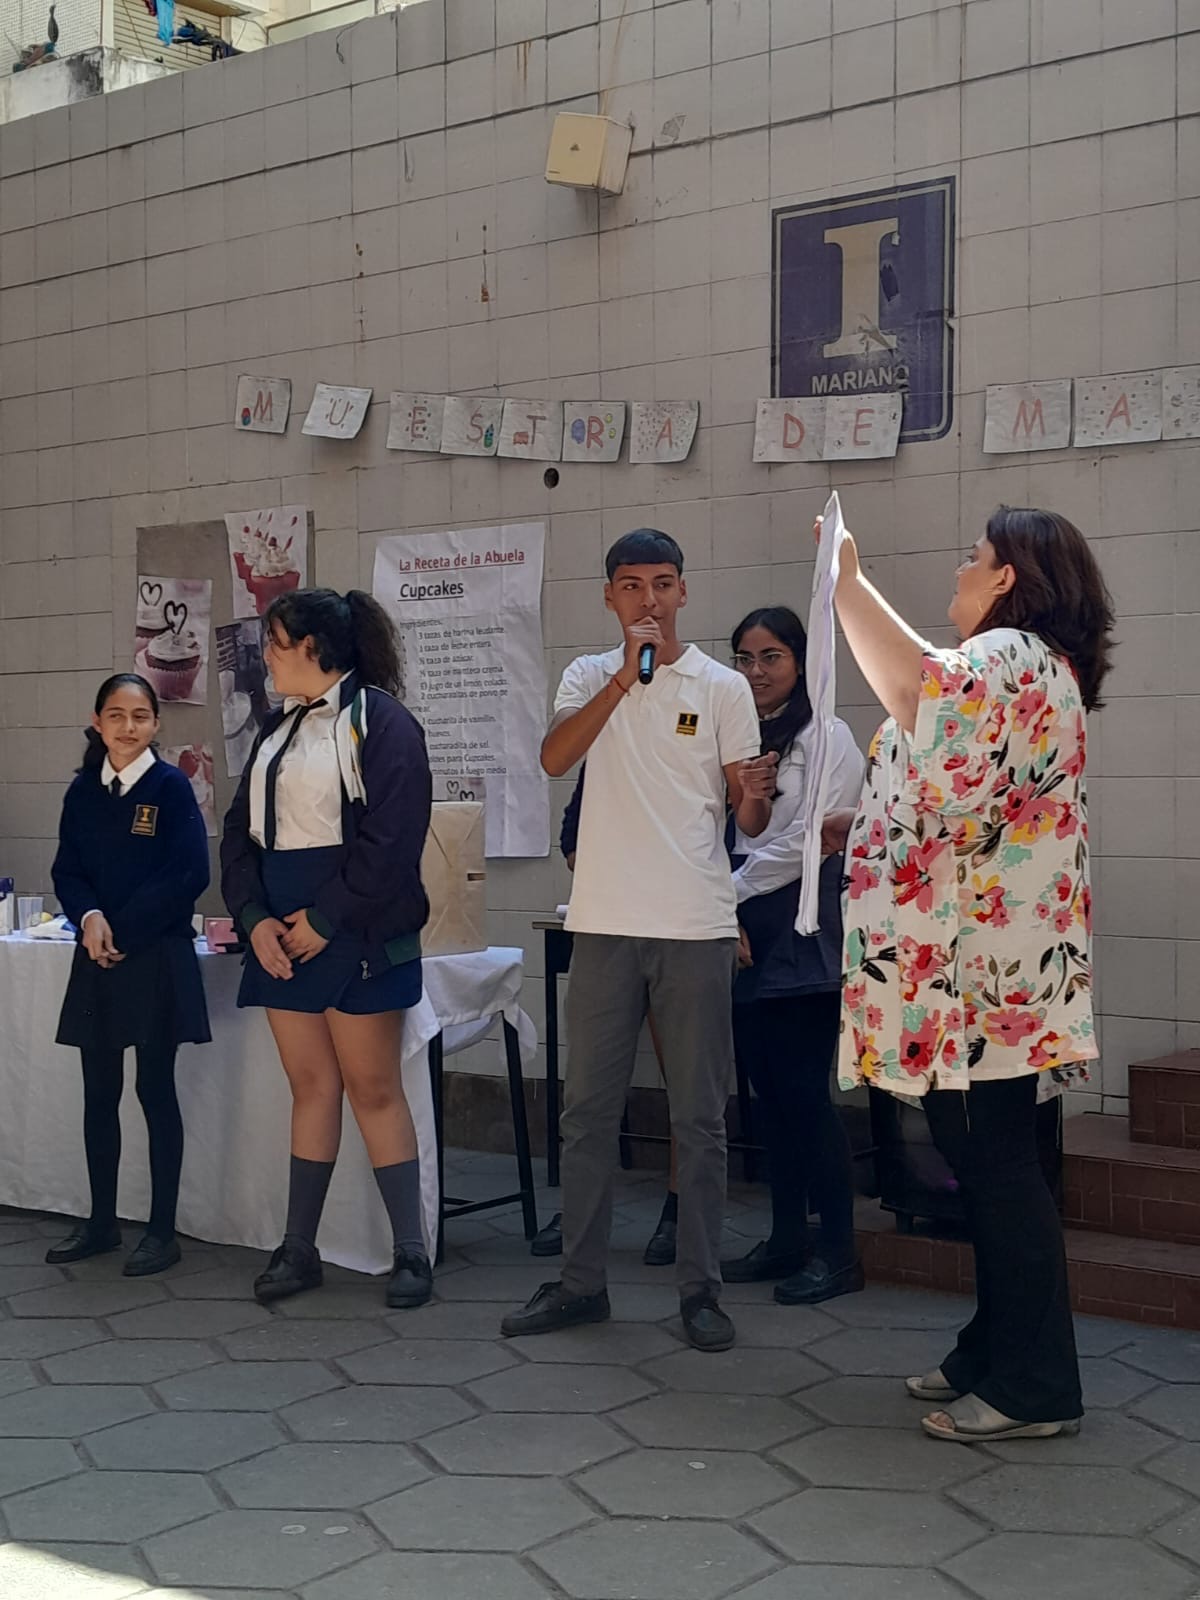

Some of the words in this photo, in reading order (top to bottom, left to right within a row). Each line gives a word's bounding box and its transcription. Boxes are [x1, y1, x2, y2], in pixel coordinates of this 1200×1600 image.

[783, 408, 875, 447] DE
[400, 558, 411, 571] La
[414, 557, 450, 570] Receta
[454, 553, 467, 567] de
[470, 551, 481, 565] la
[484, 548, 525, 564] Abuela
[400, 580, 464, 600] Cupcakes
[443, 629, 452, 638] de
[441, 642, 449, 651] de
[444, 680, 453, 689] de
[468, 740, 478, 749] de
